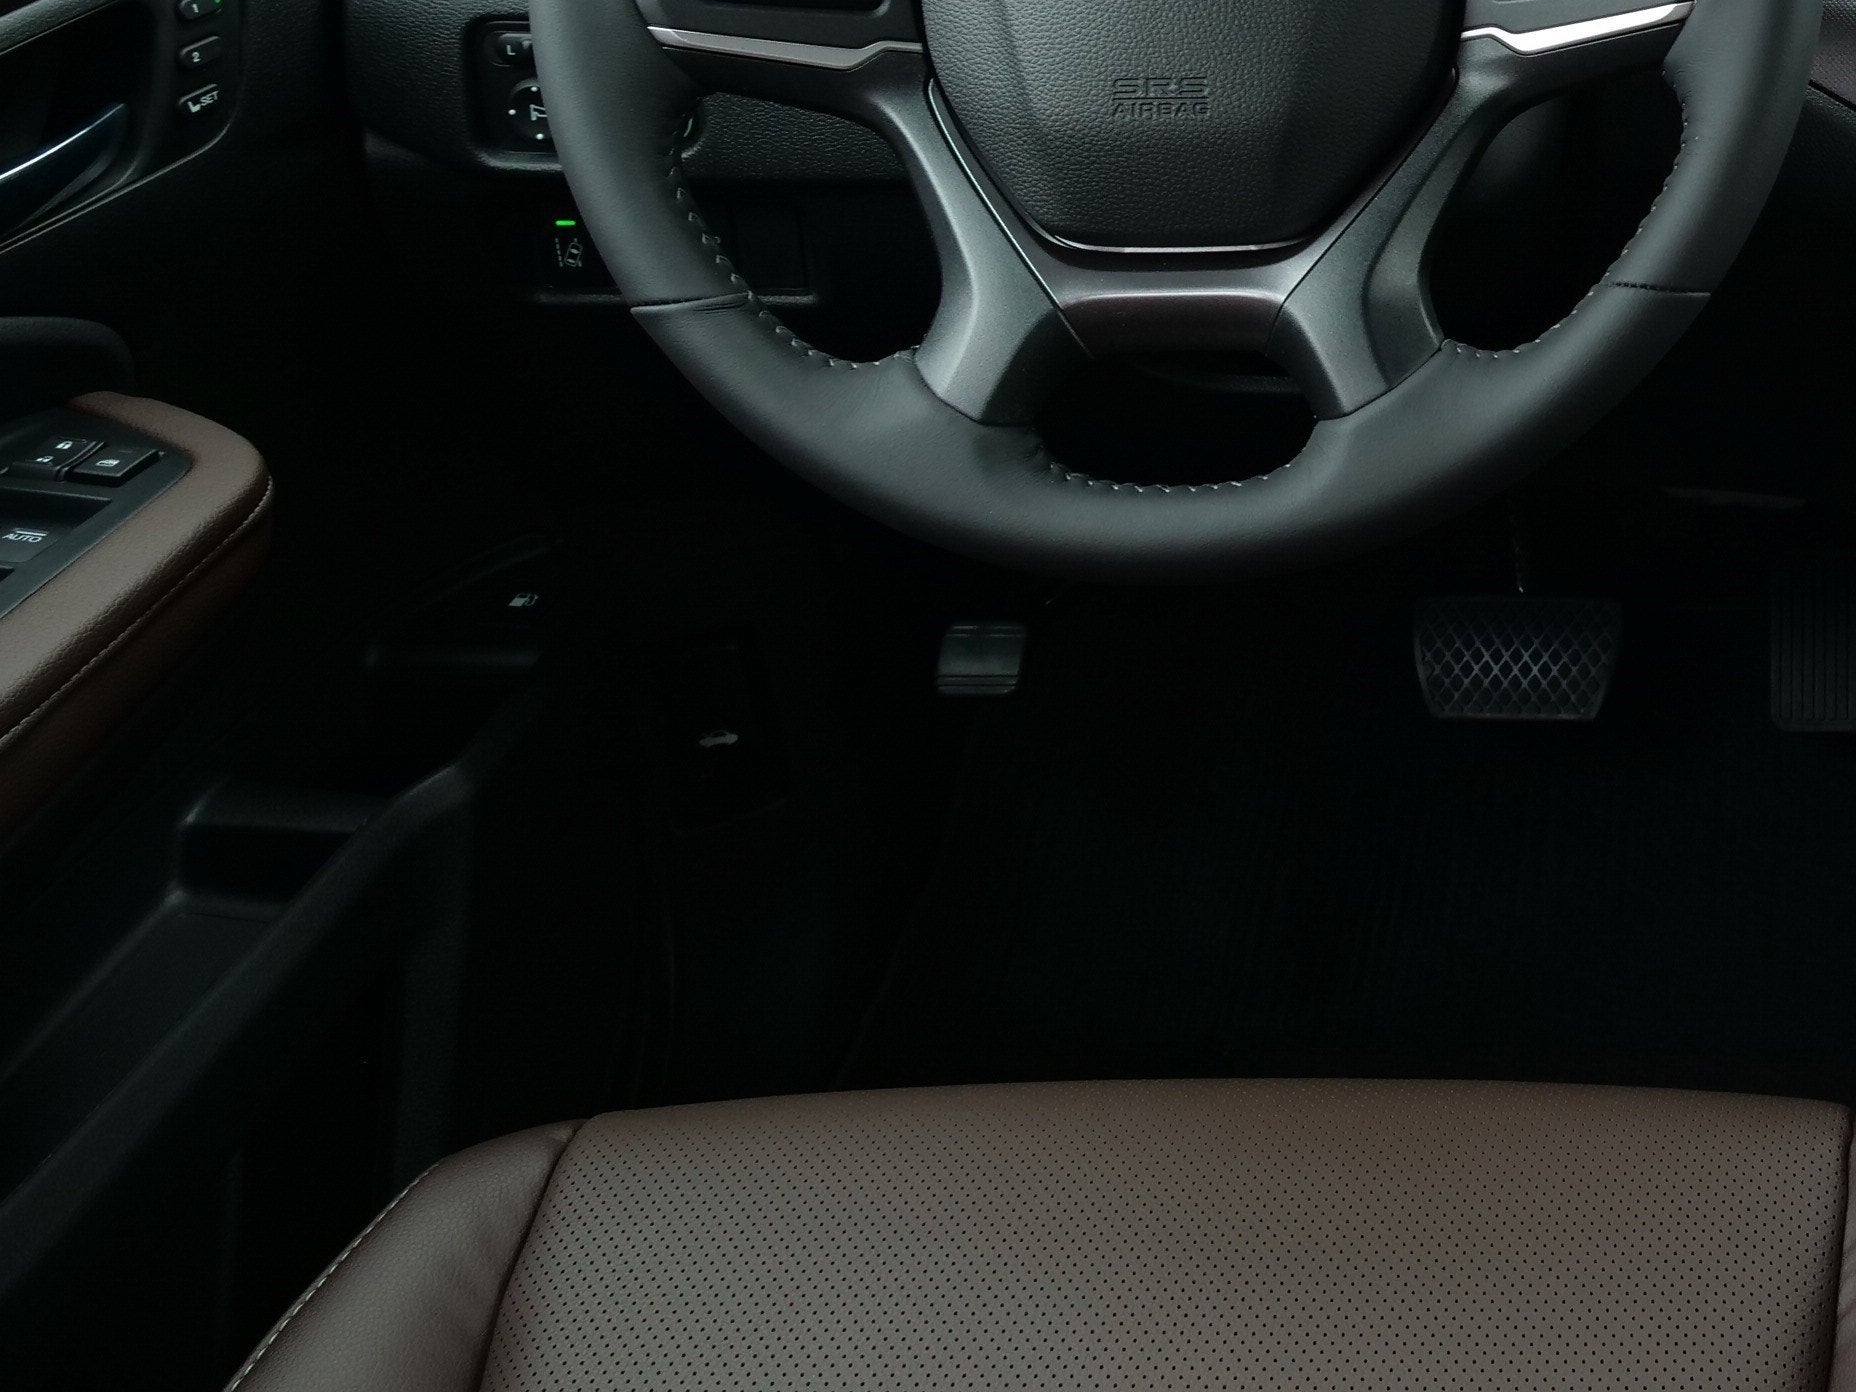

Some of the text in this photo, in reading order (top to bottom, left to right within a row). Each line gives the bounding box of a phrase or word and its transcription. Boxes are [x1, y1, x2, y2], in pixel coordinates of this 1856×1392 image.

[191, 51, 201, 63] 2
[1112, 76, 1208, 96] SRS
[200, 90, 219, 106] SET
[1112, 102, 1209, 117] AIRBAG
[2, 532, 43, 543] AUTO
